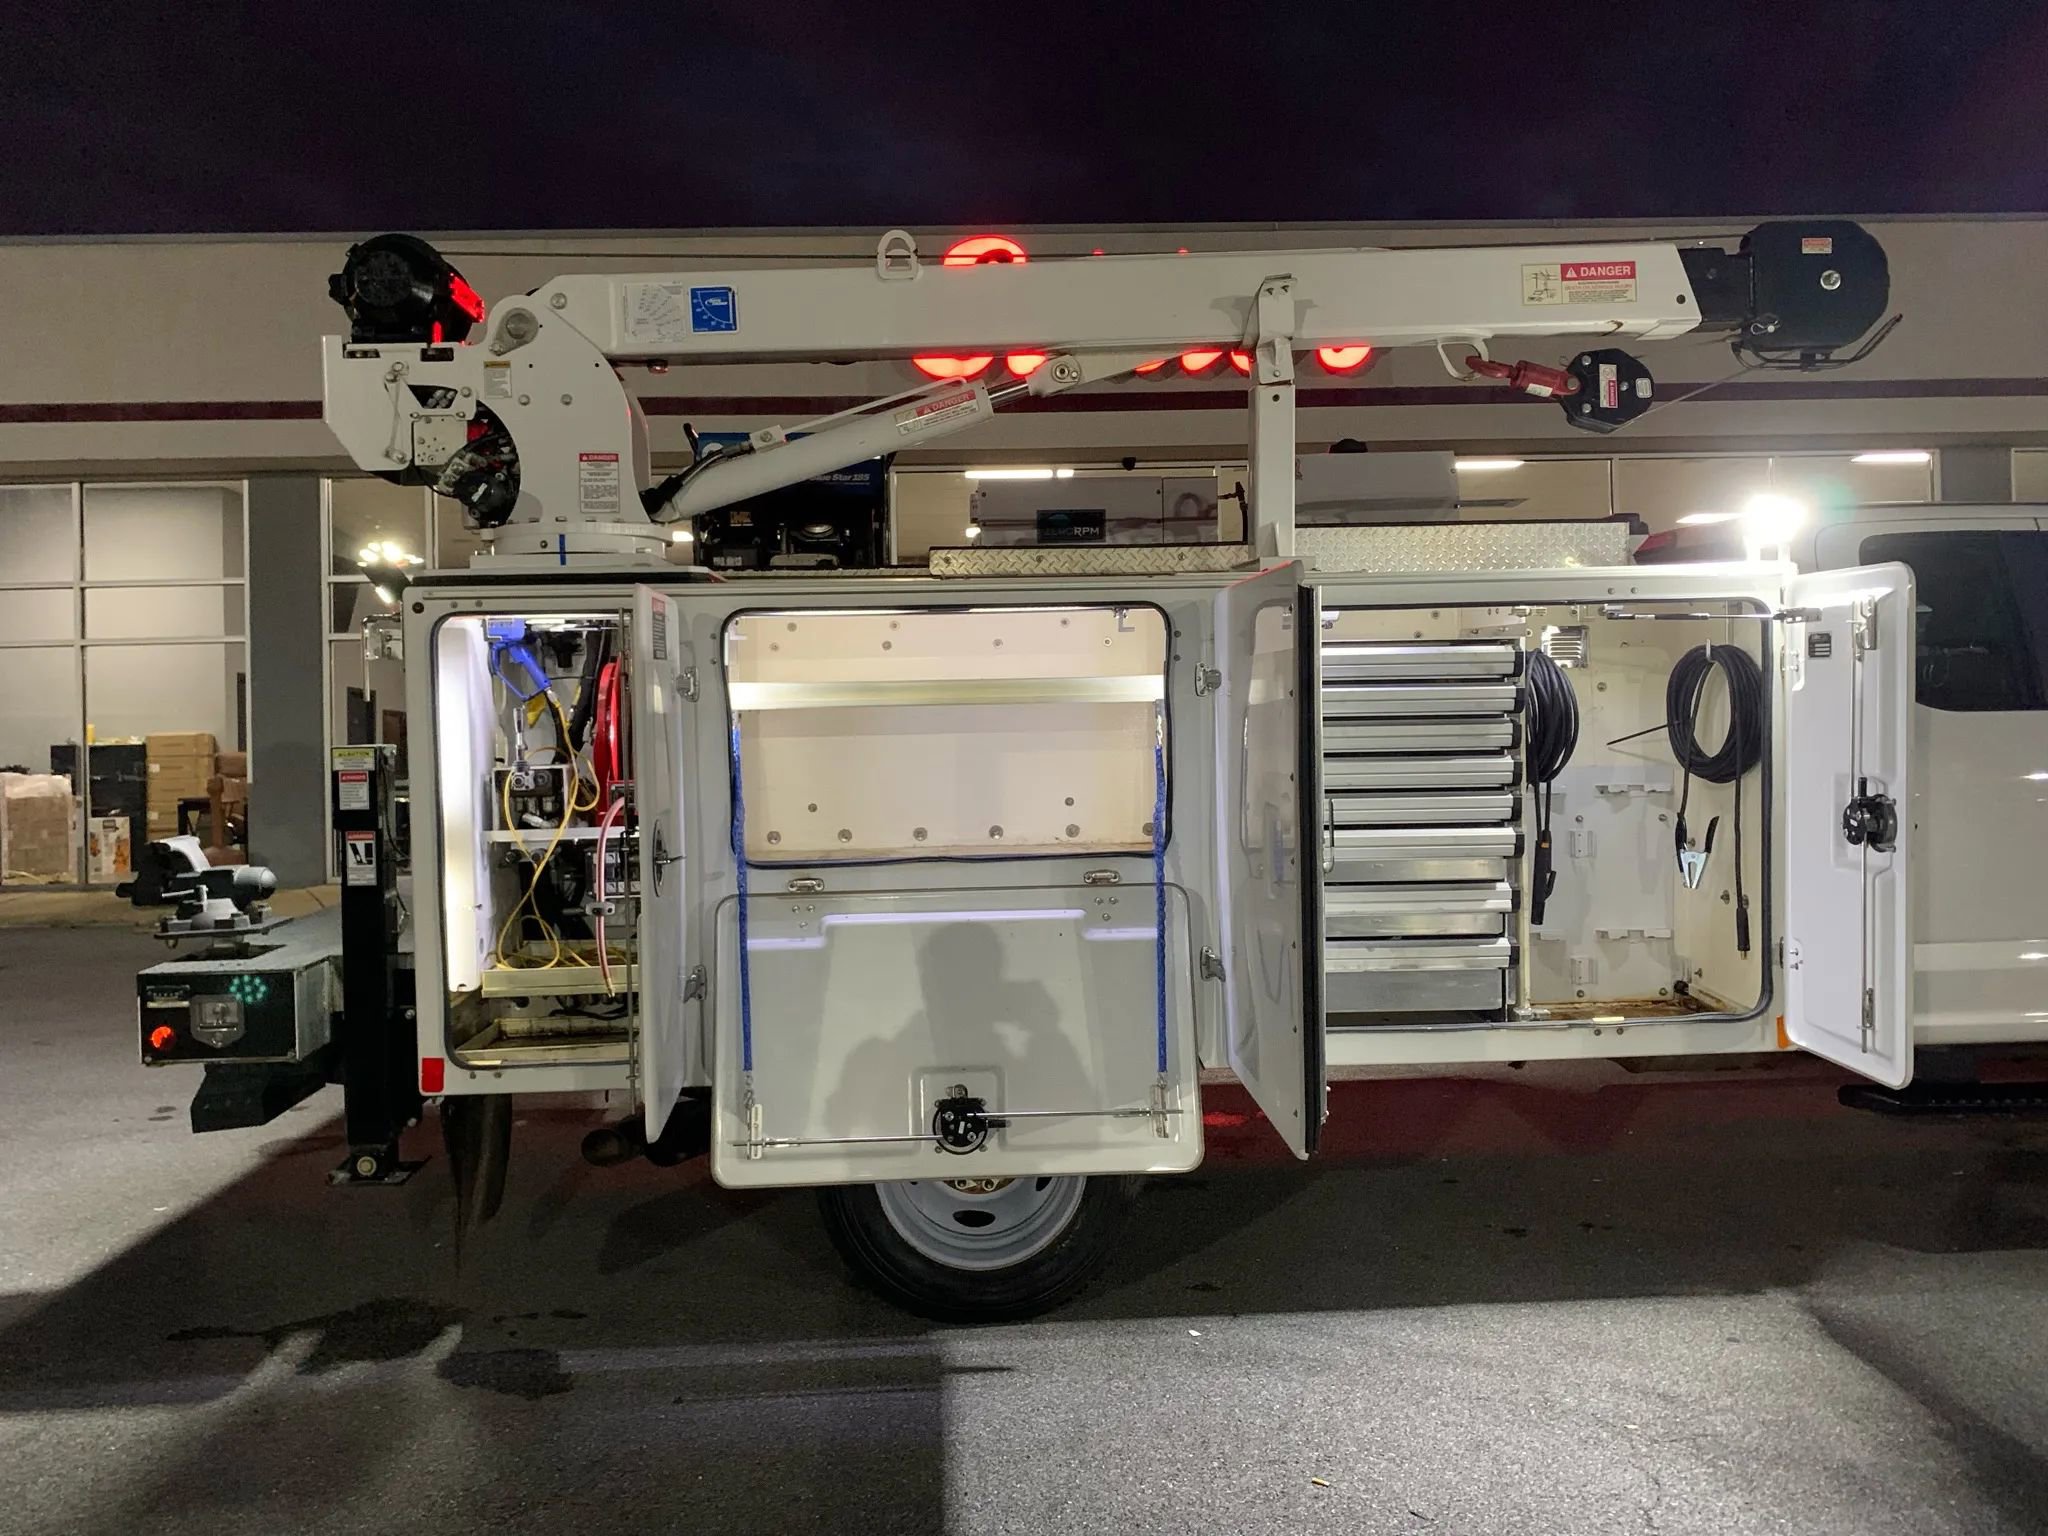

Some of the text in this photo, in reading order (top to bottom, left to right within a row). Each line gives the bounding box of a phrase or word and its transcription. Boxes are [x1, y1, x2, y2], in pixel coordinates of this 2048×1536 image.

[1580, 266, 1631, 277] DANGER
[932, 394, 971, 410] DANGER
[832, 473, 851, 481] Star
